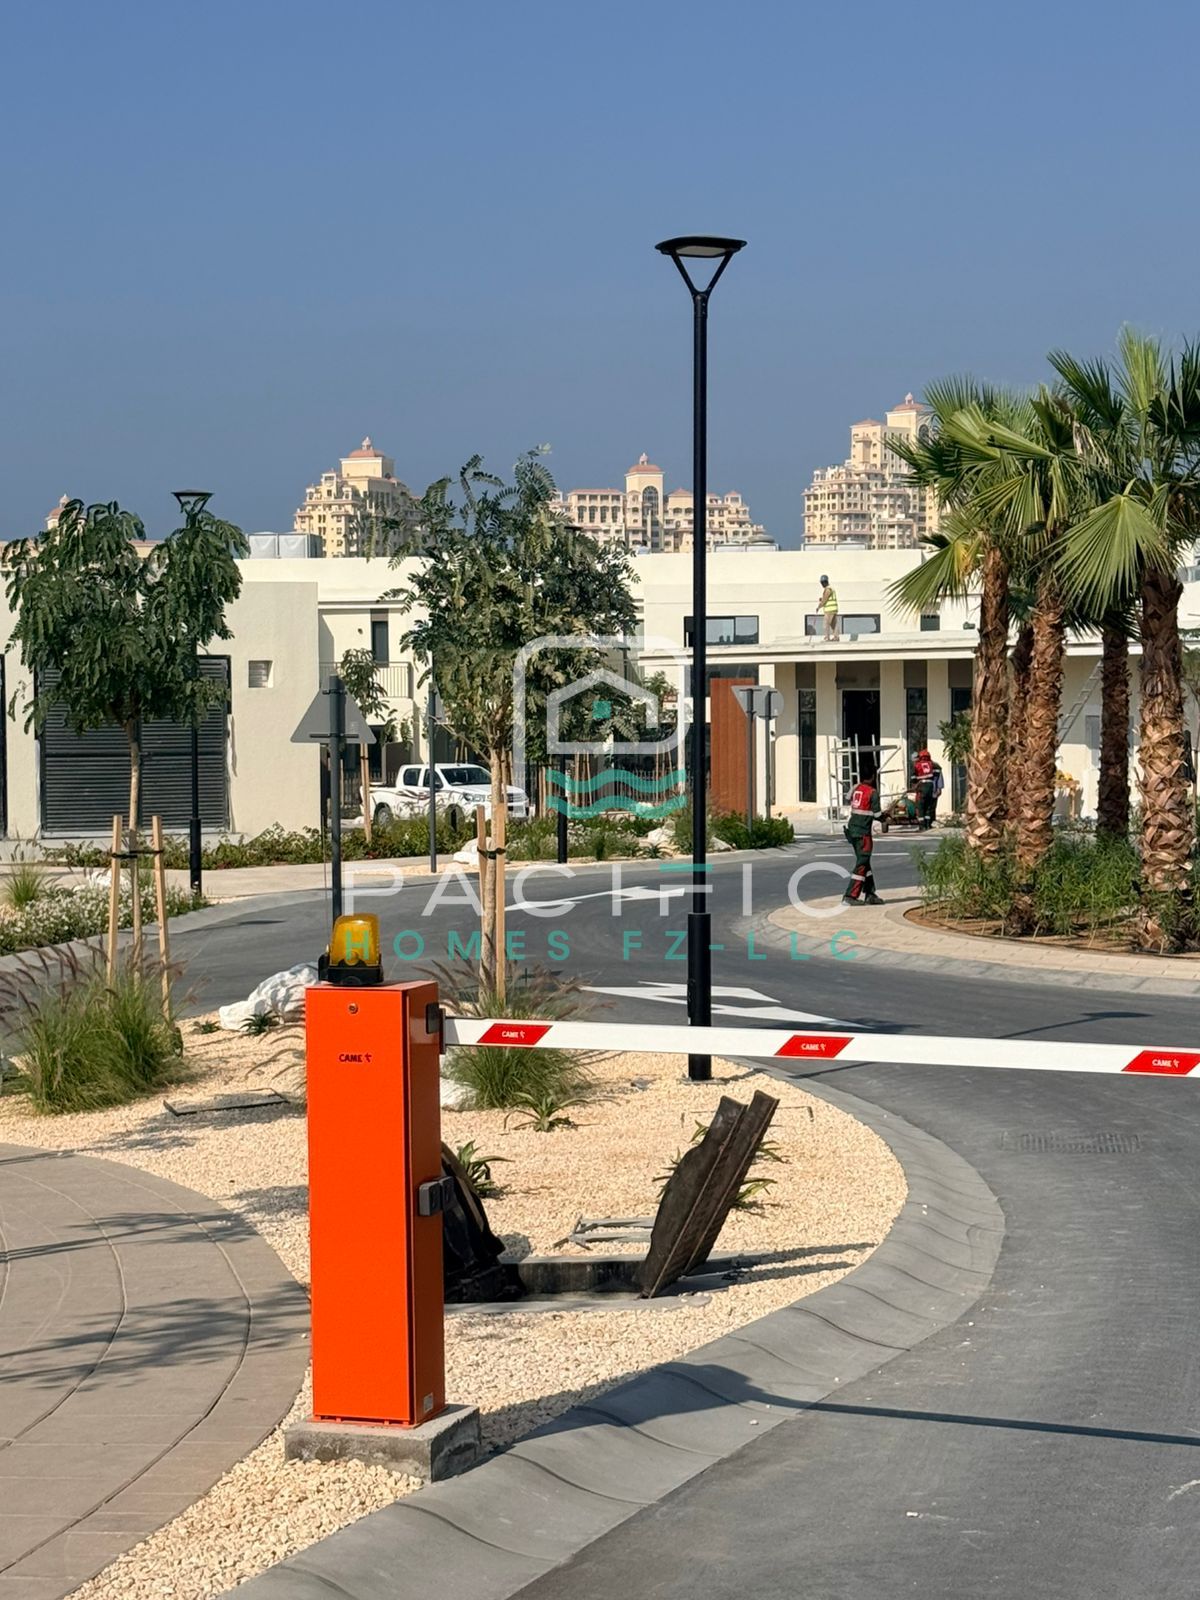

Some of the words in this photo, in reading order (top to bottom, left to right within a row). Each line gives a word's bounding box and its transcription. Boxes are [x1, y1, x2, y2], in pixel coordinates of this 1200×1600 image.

[501, 1031, 519, 1039] CAME
[801, 1043, 820, 1051] CAME
[339, 1053, 363, 1062] CAME
